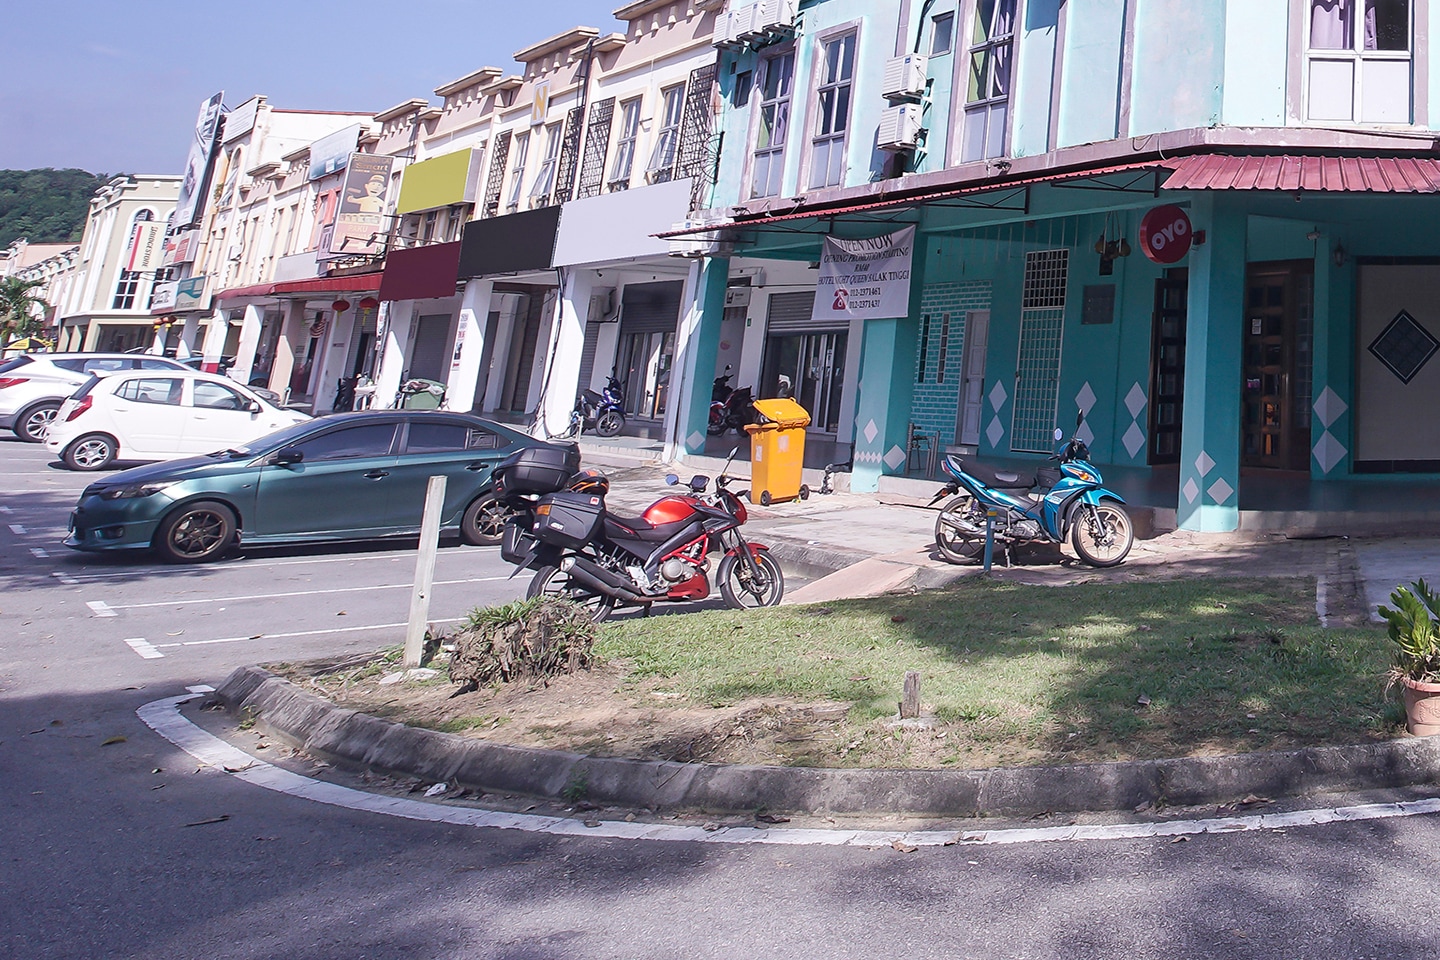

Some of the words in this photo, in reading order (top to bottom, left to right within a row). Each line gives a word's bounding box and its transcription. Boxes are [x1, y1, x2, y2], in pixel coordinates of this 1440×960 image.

[533, 85, 547, 121] N
[866, 234, 894, 250] NOW
[1151, 218, 1187, 250] OYO
[834, 275, 850, 284] NGHT
